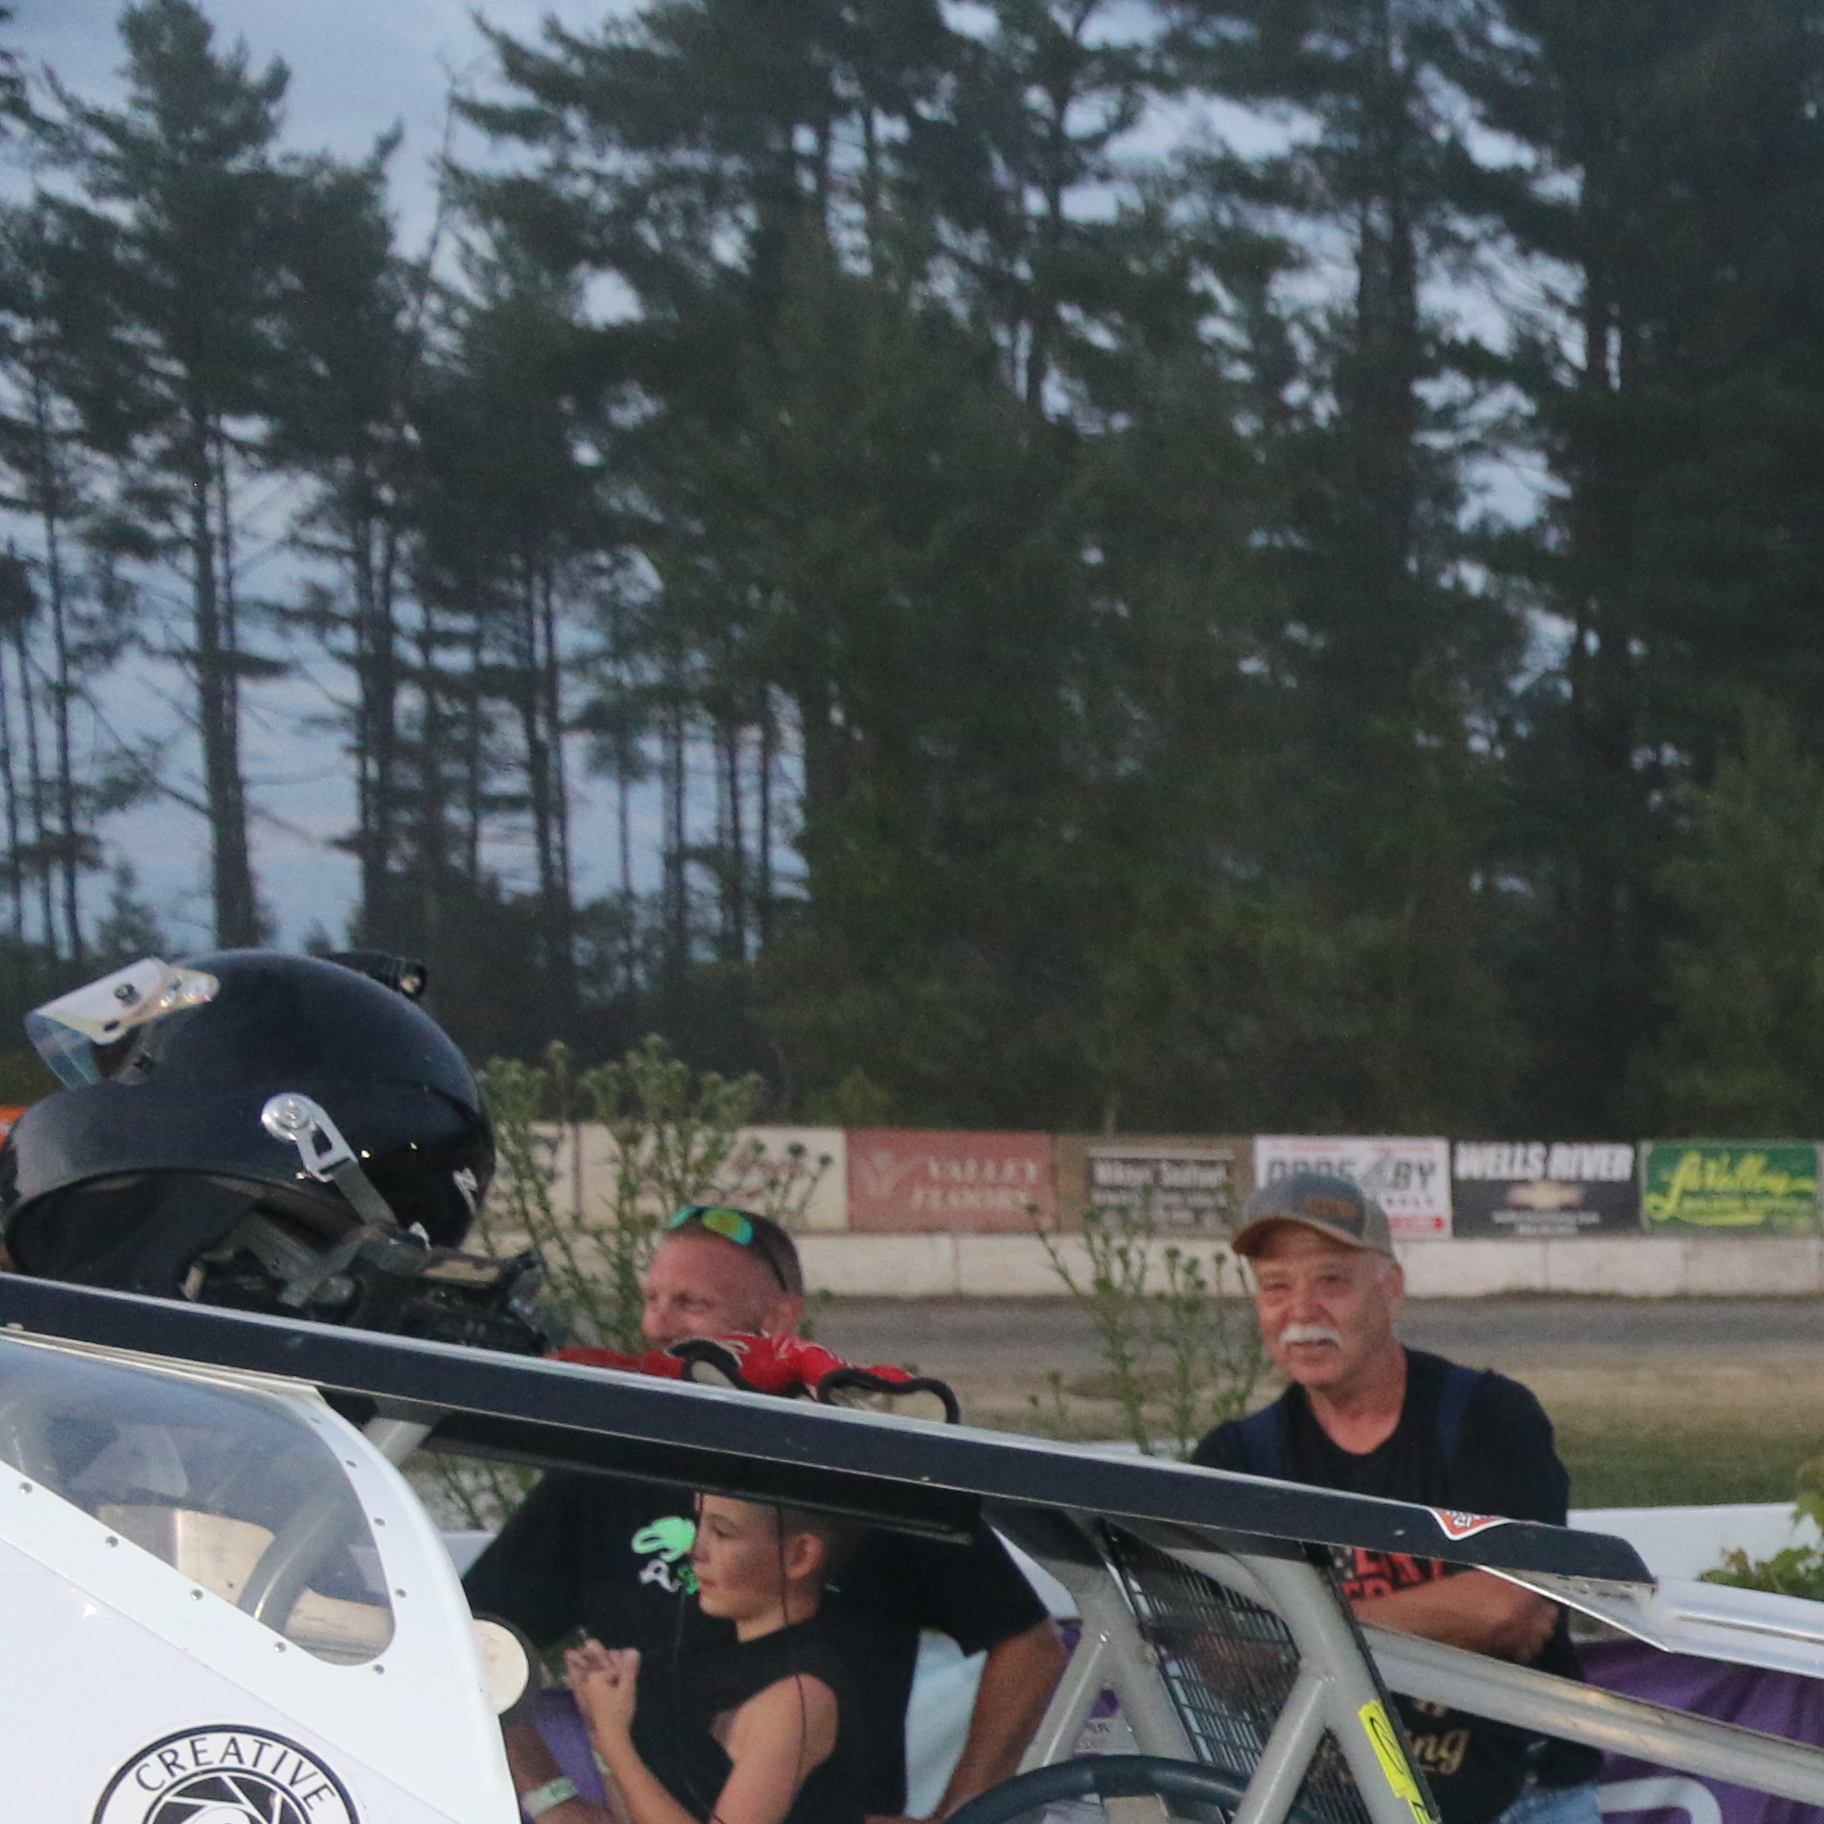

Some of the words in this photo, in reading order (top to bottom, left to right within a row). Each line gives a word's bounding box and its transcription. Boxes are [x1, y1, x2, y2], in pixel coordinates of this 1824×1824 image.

[1454, 1142, 1547, 1181] WELLS
[1548, 1143, 1635, 1182] RIVER
[135, 1736, 336, 1811] CREATIVE
